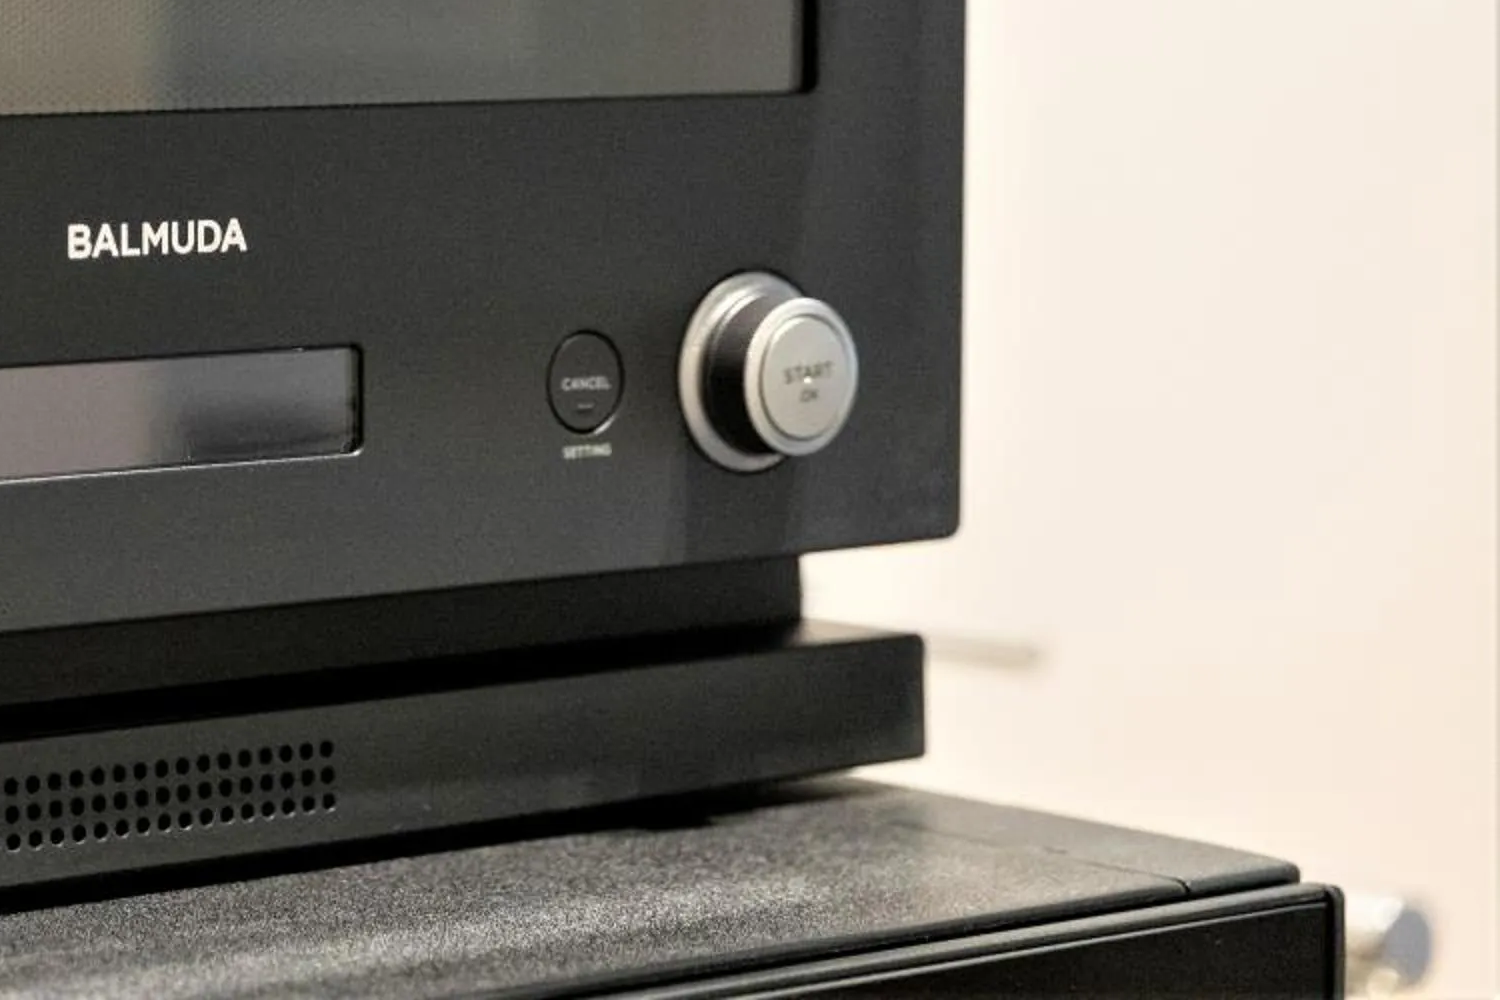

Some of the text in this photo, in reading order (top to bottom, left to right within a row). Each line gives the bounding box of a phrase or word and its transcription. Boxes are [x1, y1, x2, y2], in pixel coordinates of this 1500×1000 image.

[67, 217, 248, 259] BALMUDA
[561, 375, 612, 391] CANCEL
[783, 360, 834, 385] START
[562, 442, 612, 459] SETTING
